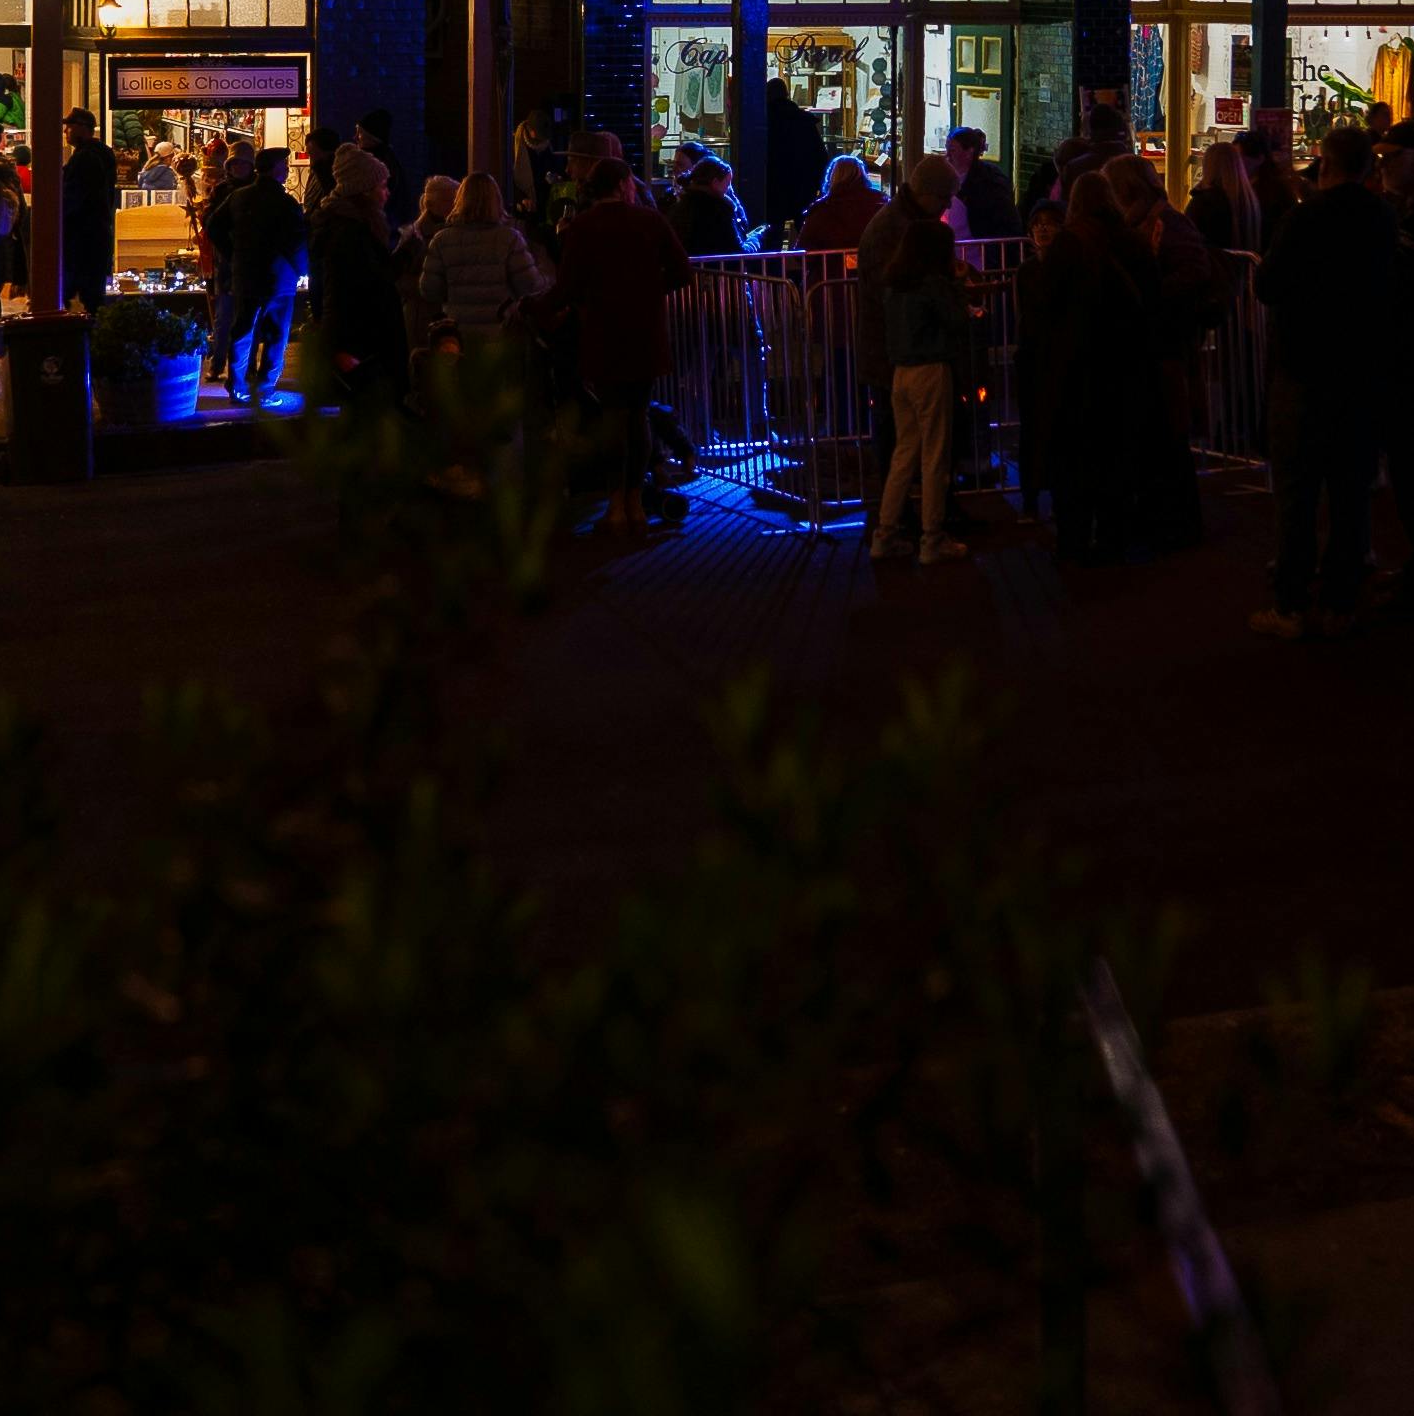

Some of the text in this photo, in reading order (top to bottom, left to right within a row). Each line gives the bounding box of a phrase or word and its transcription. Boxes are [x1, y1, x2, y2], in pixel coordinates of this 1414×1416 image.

[666, 33, 869, 77] Cap Road
[121, 76, 295, 91] Lollies & Chocolates
[1216, 110, 1243, 123] OPEN
